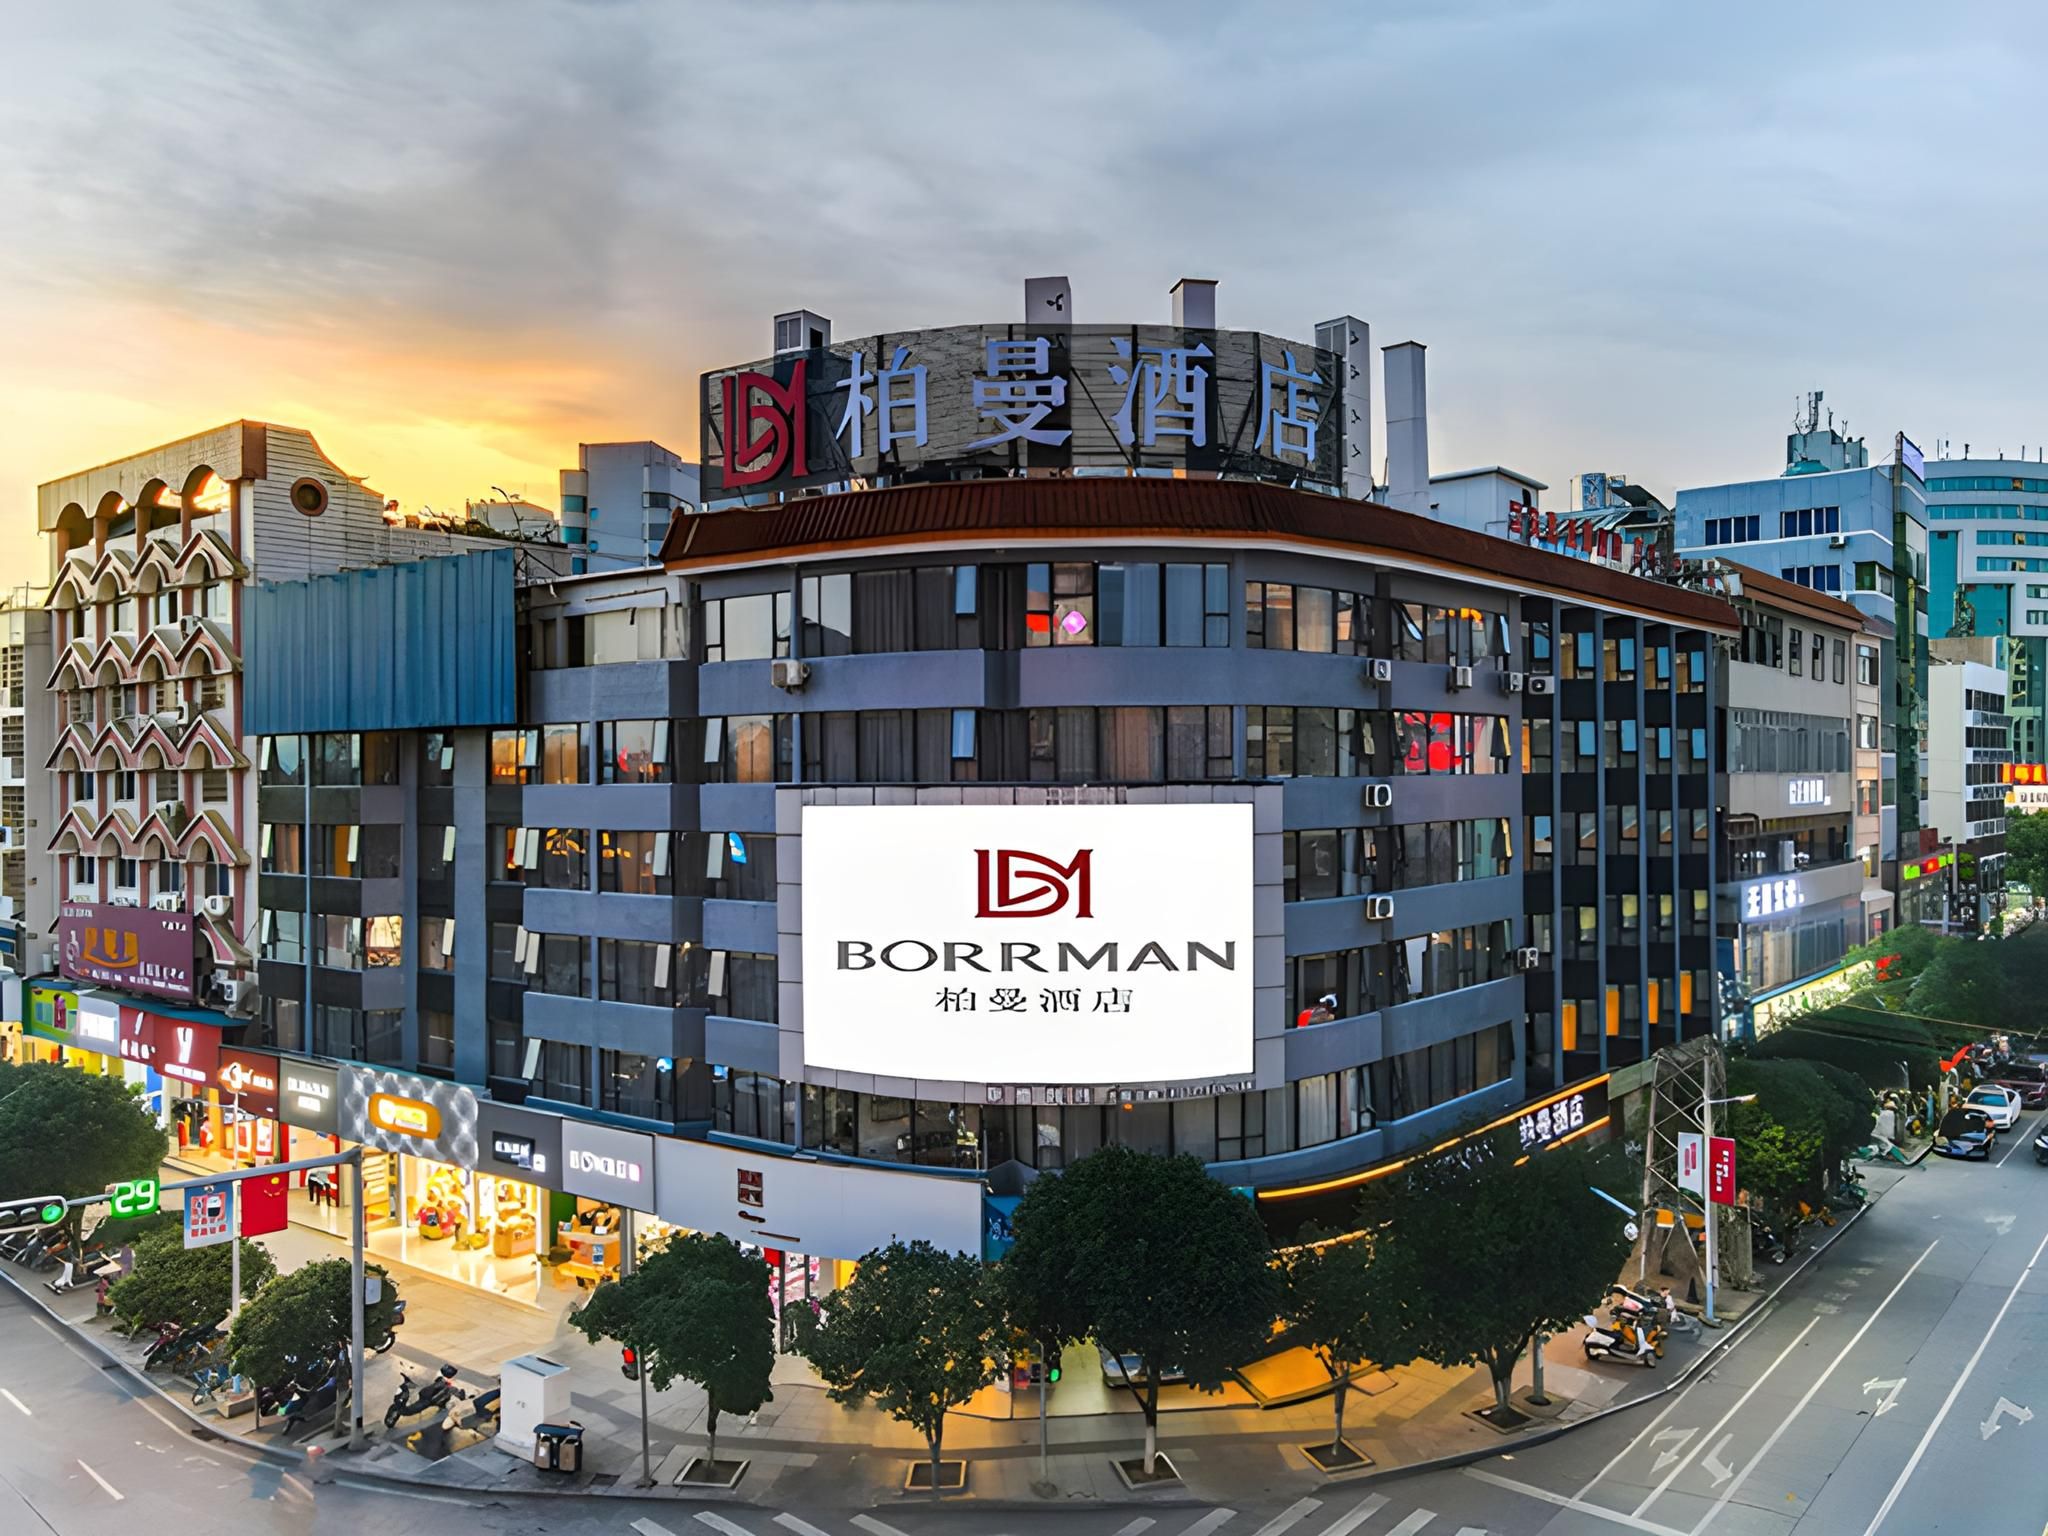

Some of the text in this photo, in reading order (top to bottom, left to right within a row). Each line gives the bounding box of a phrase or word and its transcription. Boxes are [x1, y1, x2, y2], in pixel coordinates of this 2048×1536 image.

[835, 337, 1322, 463] 柏曼酒店
[836, 940, 1236, 973] BORRMAN
[935, 987, 1134, 1014] 柏曼酒店
[115, 1180, 155, 1214] 29
